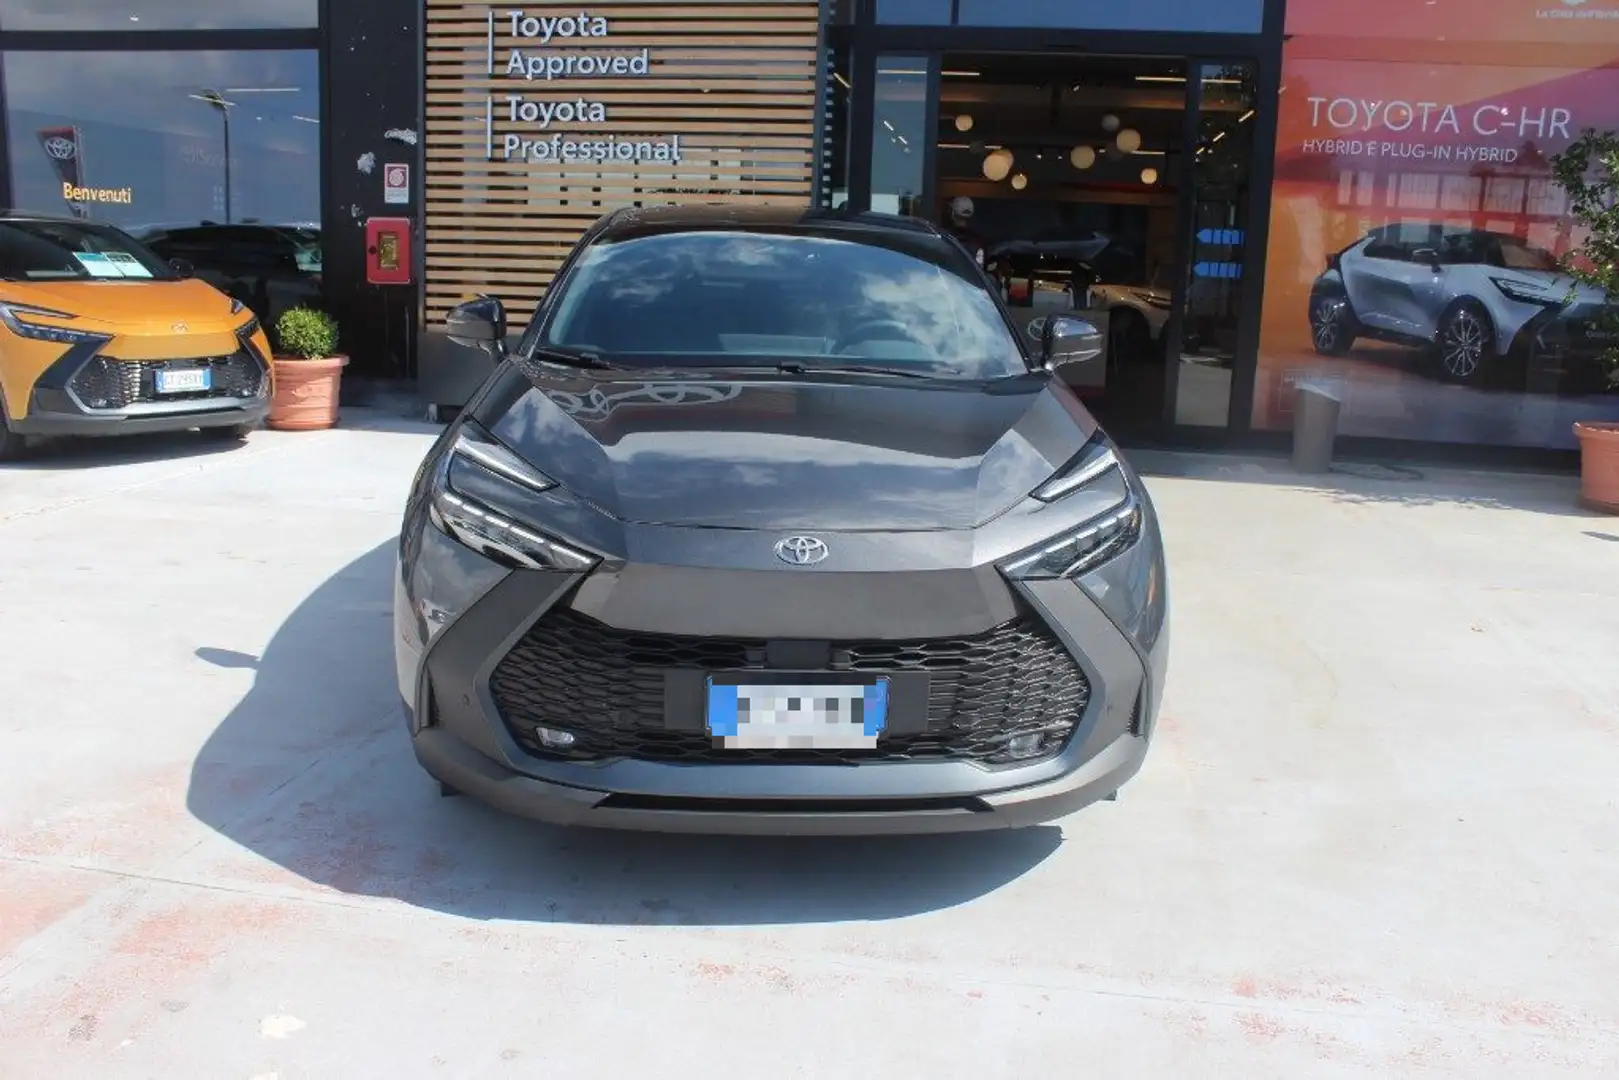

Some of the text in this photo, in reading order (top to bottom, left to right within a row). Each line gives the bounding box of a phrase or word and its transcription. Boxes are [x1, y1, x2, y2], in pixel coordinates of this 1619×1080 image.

[506, 11, 608, 44] Toyota
[506, 48, 649, 81] Approved
[505, 96, 606, 129] Toyota
[1307, 97, 1571, 139] TOYOTA C-HR
[504, 133, 682, 161] Professional
[1302, 139, 1363, 156] HYBRID
[1381, 142, 1452, 160] PLUG-IN
[1456, 146, 1518, 164] HYBRID
[63, 181, 131, 204] Benvenuti
